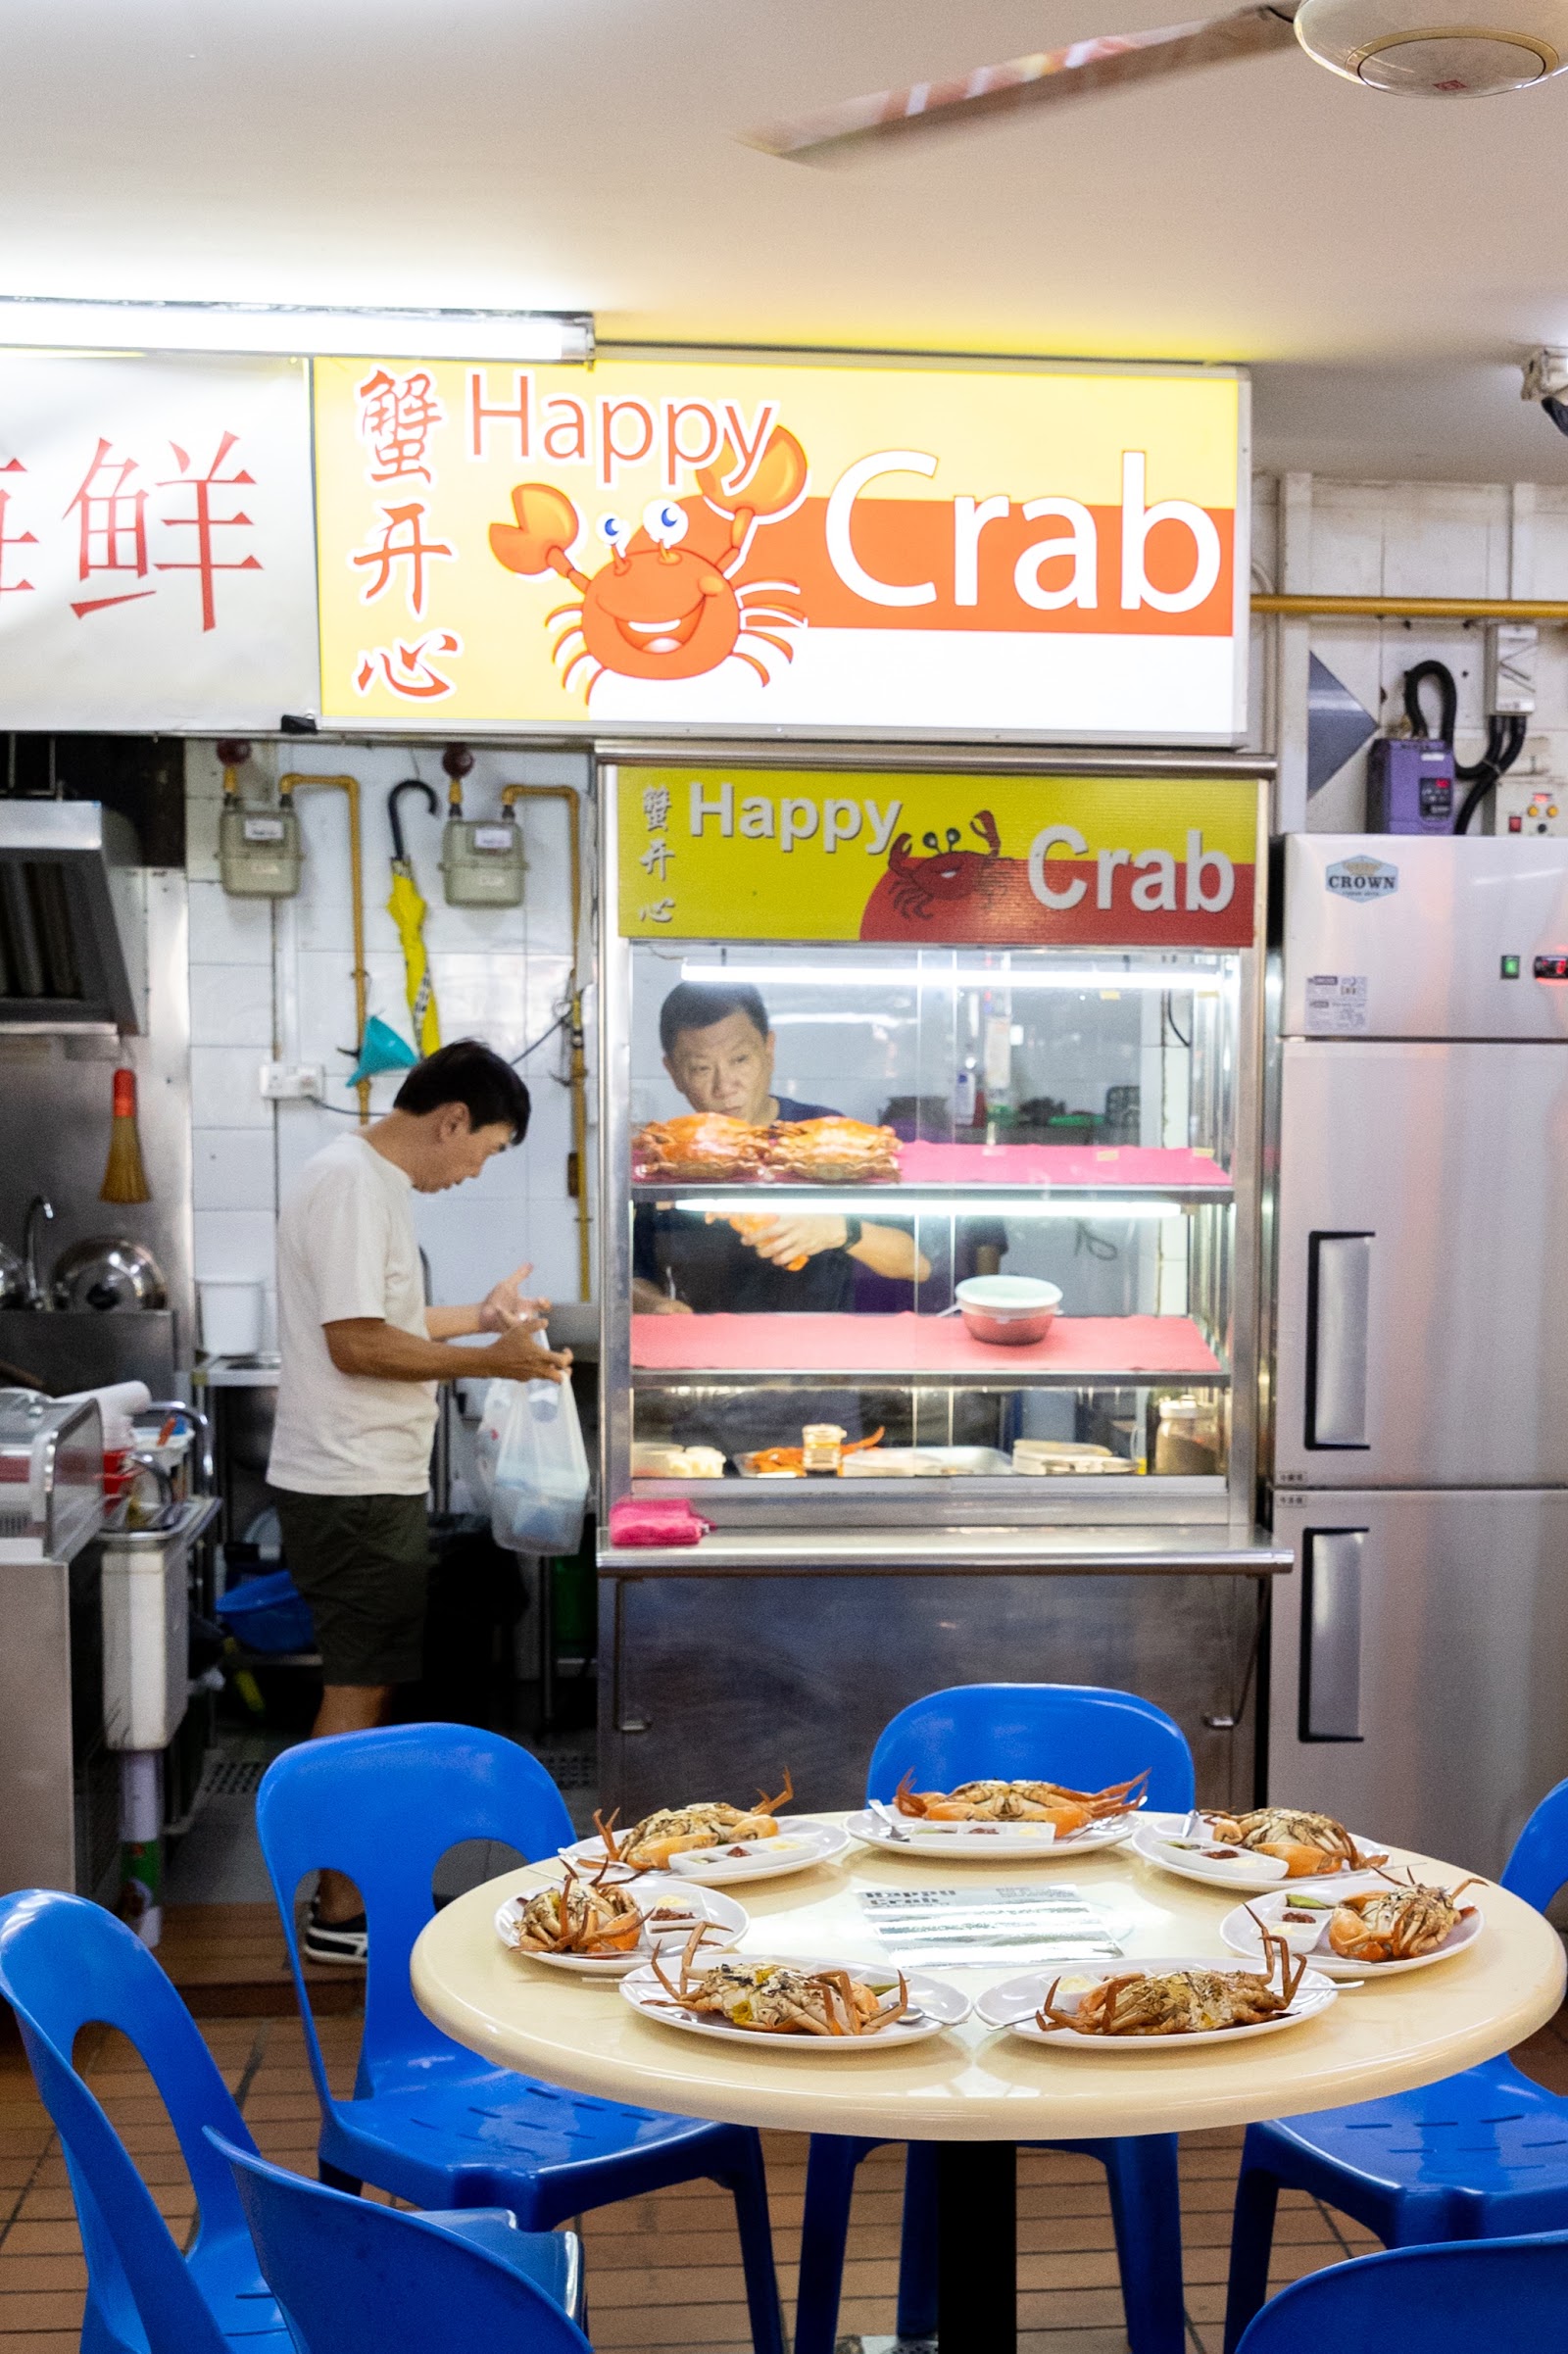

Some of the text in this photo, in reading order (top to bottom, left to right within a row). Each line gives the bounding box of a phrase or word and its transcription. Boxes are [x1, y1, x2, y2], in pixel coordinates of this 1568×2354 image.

[471, 373, 1221, 613] Happy Crab
[690, 782, 1235, 912] Happy Crab
[1329, 875, 1396, 889] CROWN
